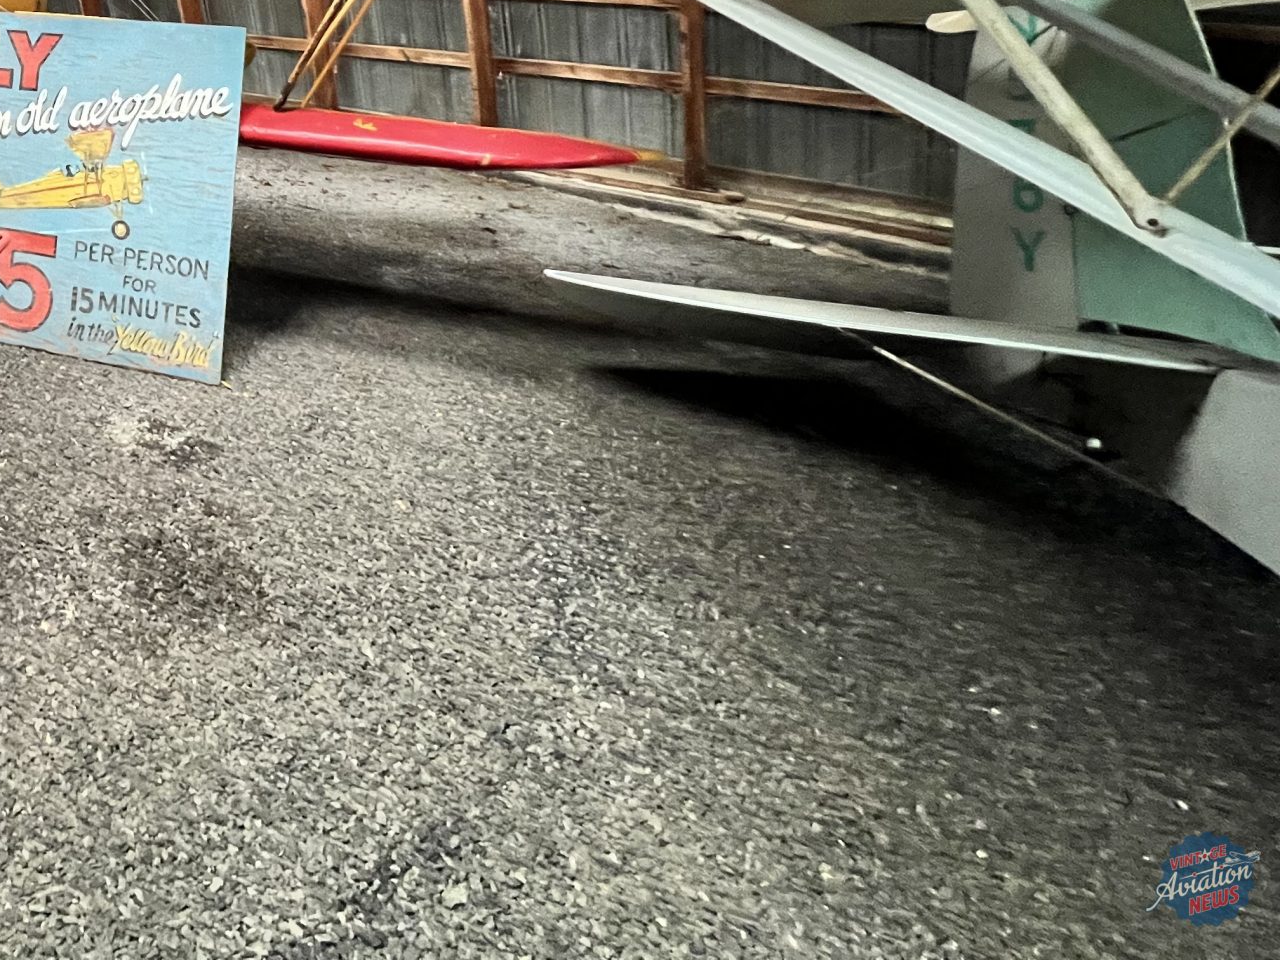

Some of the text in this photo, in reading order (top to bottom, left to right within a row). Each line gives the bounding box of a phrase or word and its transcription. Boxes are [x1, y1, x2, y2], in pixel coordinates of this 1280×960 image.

[16, 86, 68, 135] old
[69, 73, 234, 150] aeroplane
[74, 240, 209, 280] PER PERSON
[122, 275, 157, 294] FOR
[70, 286, 201, 328] 15 MINUTES
[67, 317, 86, 341] in
[88, 323, 114, 344] the
